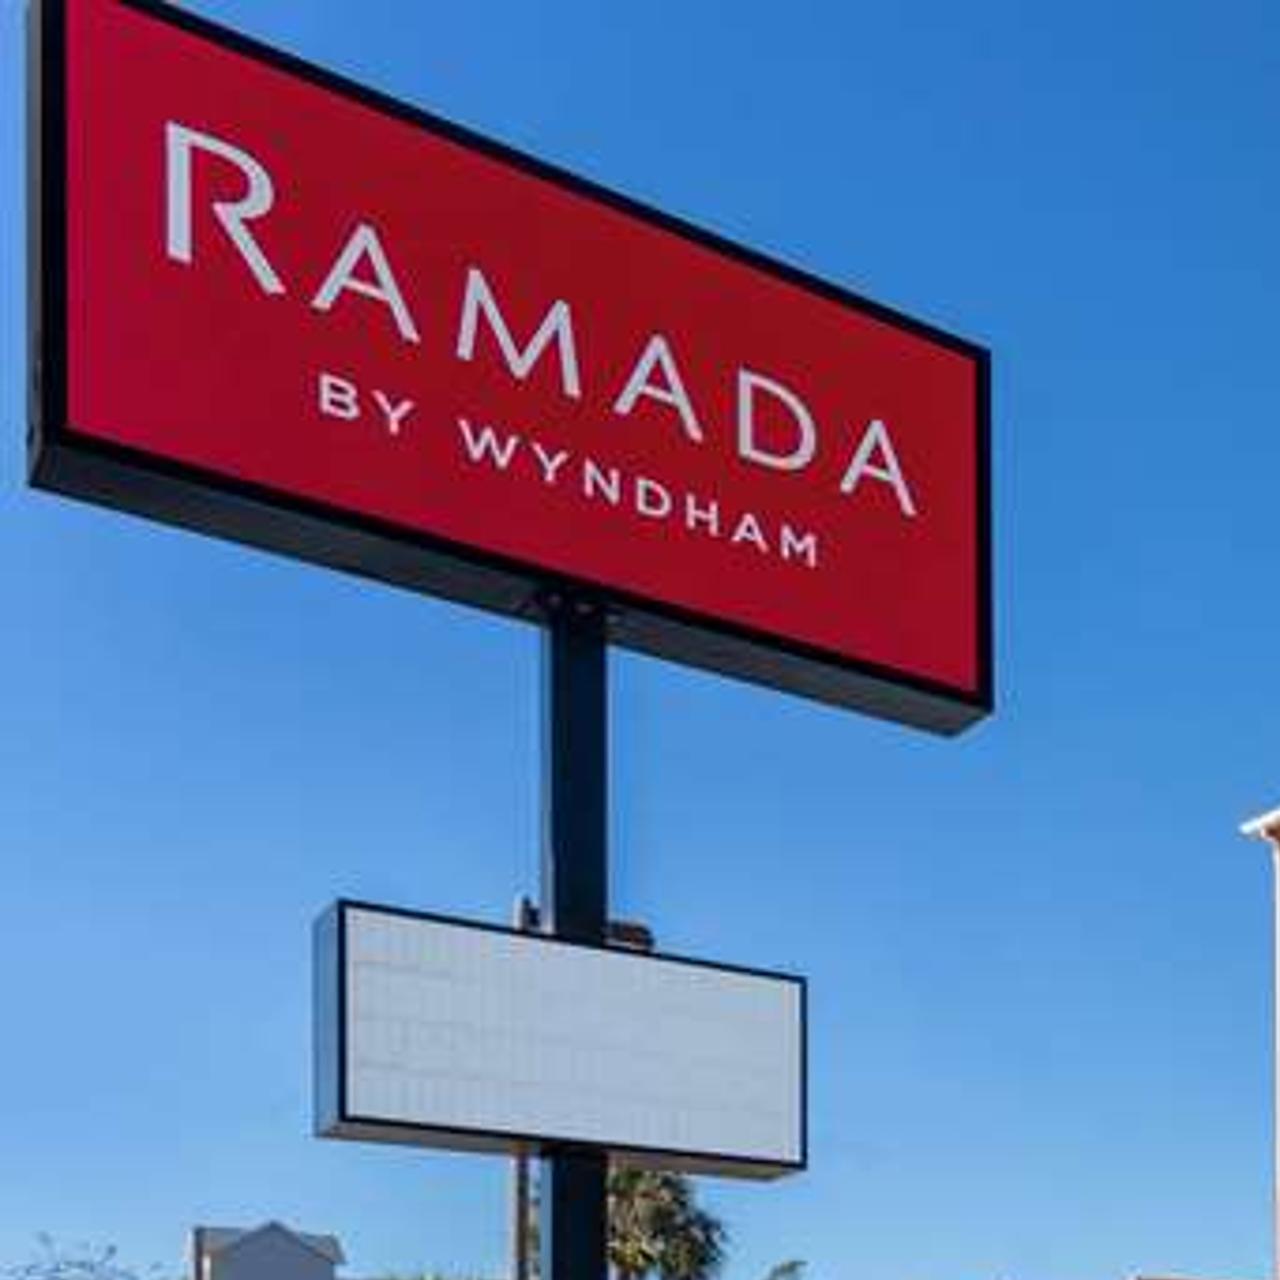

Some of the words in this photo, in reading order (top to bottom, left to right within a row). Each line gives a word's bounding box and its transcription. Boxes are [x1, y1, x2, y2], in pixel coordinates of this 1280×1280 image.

[165, 121, 917, 517] RAMADA
[318, 373, 413, 433] BY
[458, 418, 817, 567] WYNDHAM
